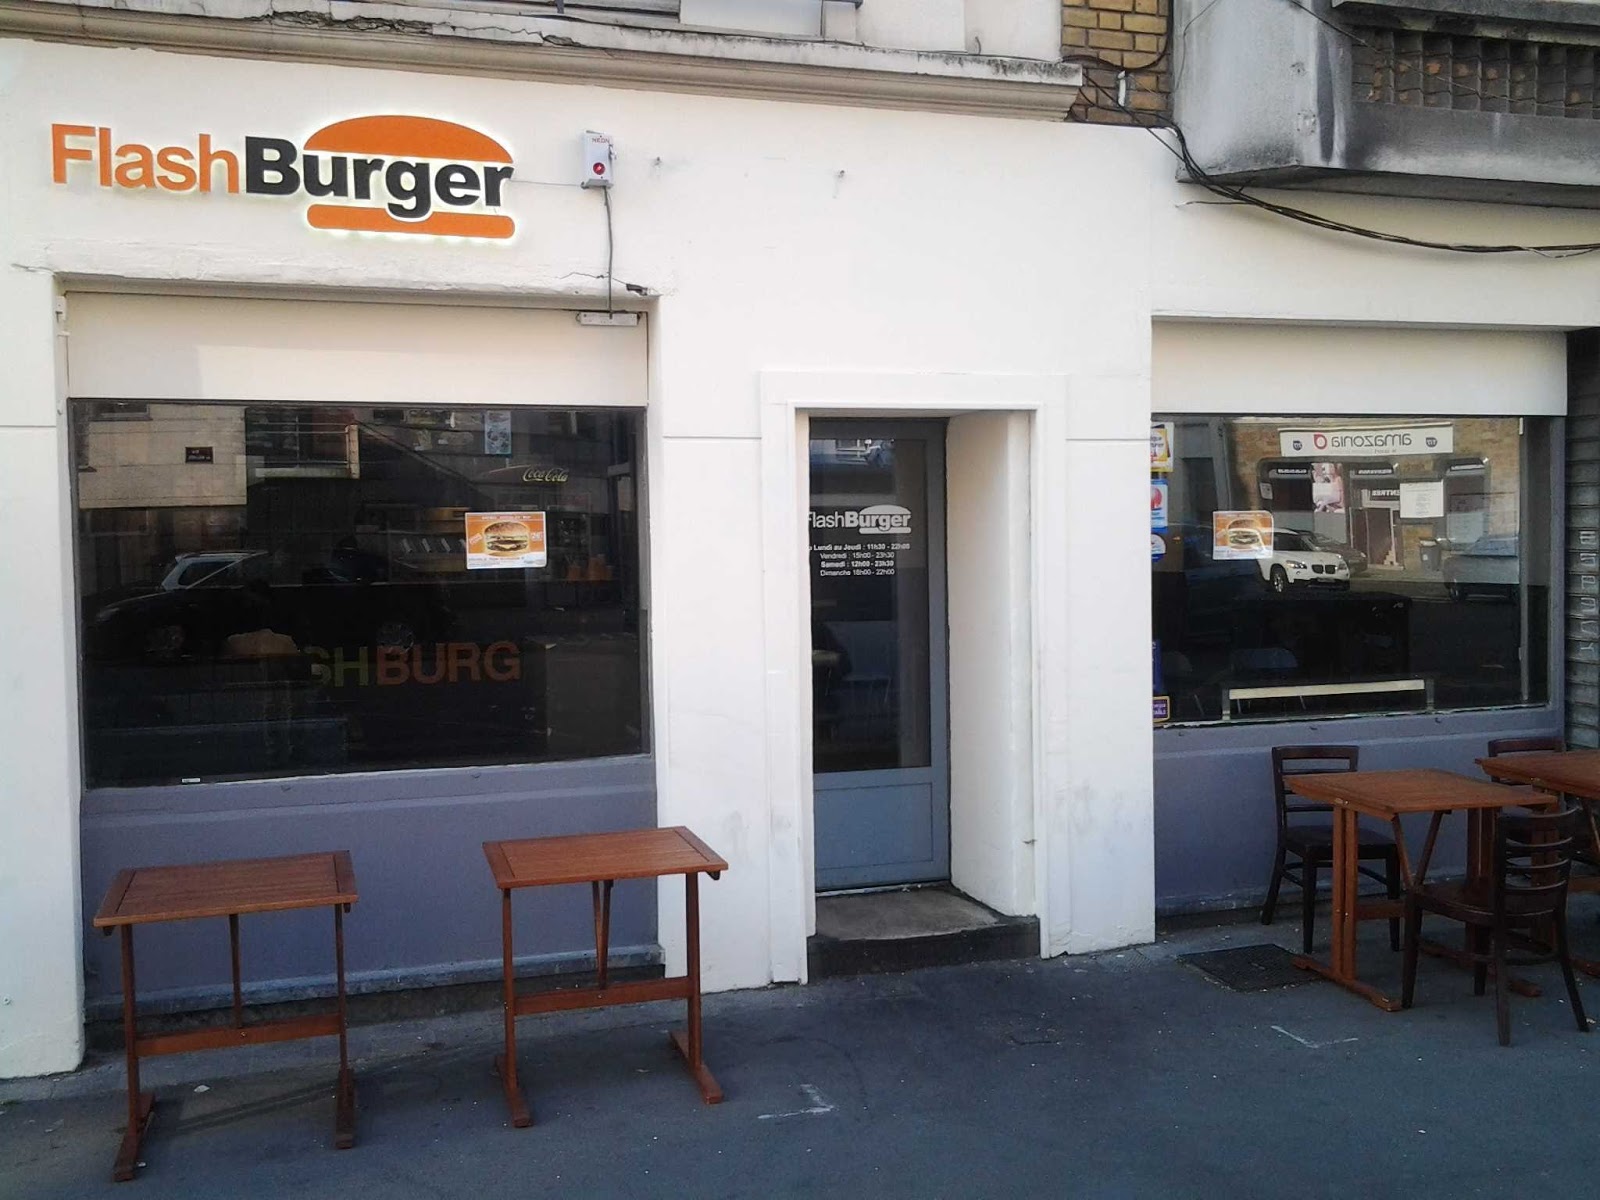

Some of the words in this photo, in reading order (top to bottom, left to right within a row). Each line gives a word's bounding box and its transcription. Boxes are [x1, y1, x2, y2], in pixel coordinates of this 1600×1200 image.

[51, 122, 515, 219] FlashBurger
[813, 543, 833, 551] Lundi
[843, 543, 862, 551] Jeudi
[820, 552, 847, 560] Vendredi
[820, 569, 851, 577] Dimanche
